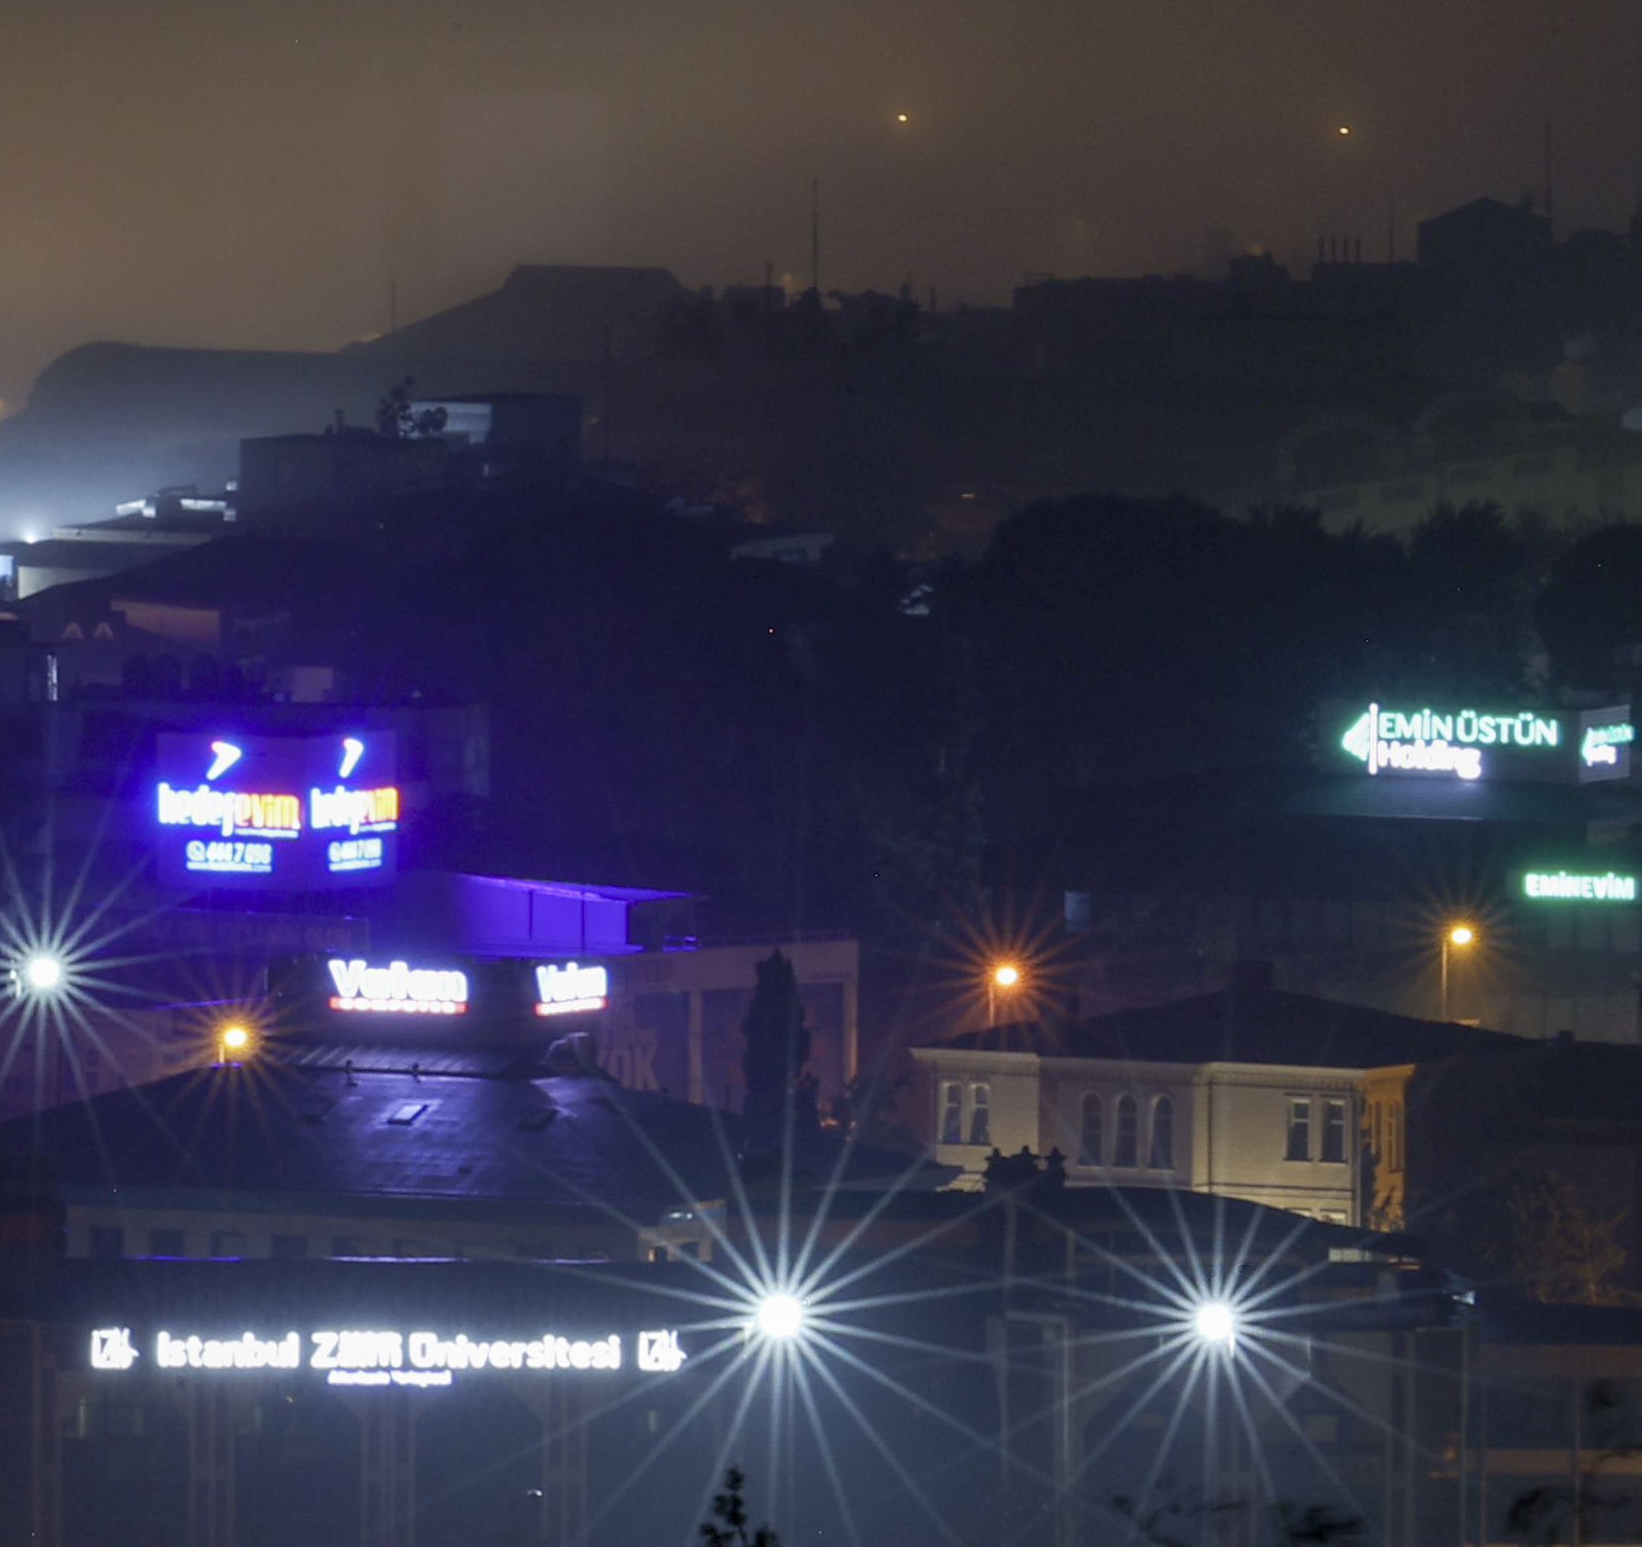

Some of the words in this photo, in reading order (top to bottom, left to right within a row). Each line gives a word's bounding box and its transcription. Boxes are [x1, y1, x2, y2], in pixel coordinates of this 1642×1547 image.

[1378, 707, 1453, 741] EMİN
[1456, 710, 1558, 746] ÜSTÜN
[1377, 739, 1482, 779] Holding
[1525, 870, 1636, 900] EMİNEVİM
